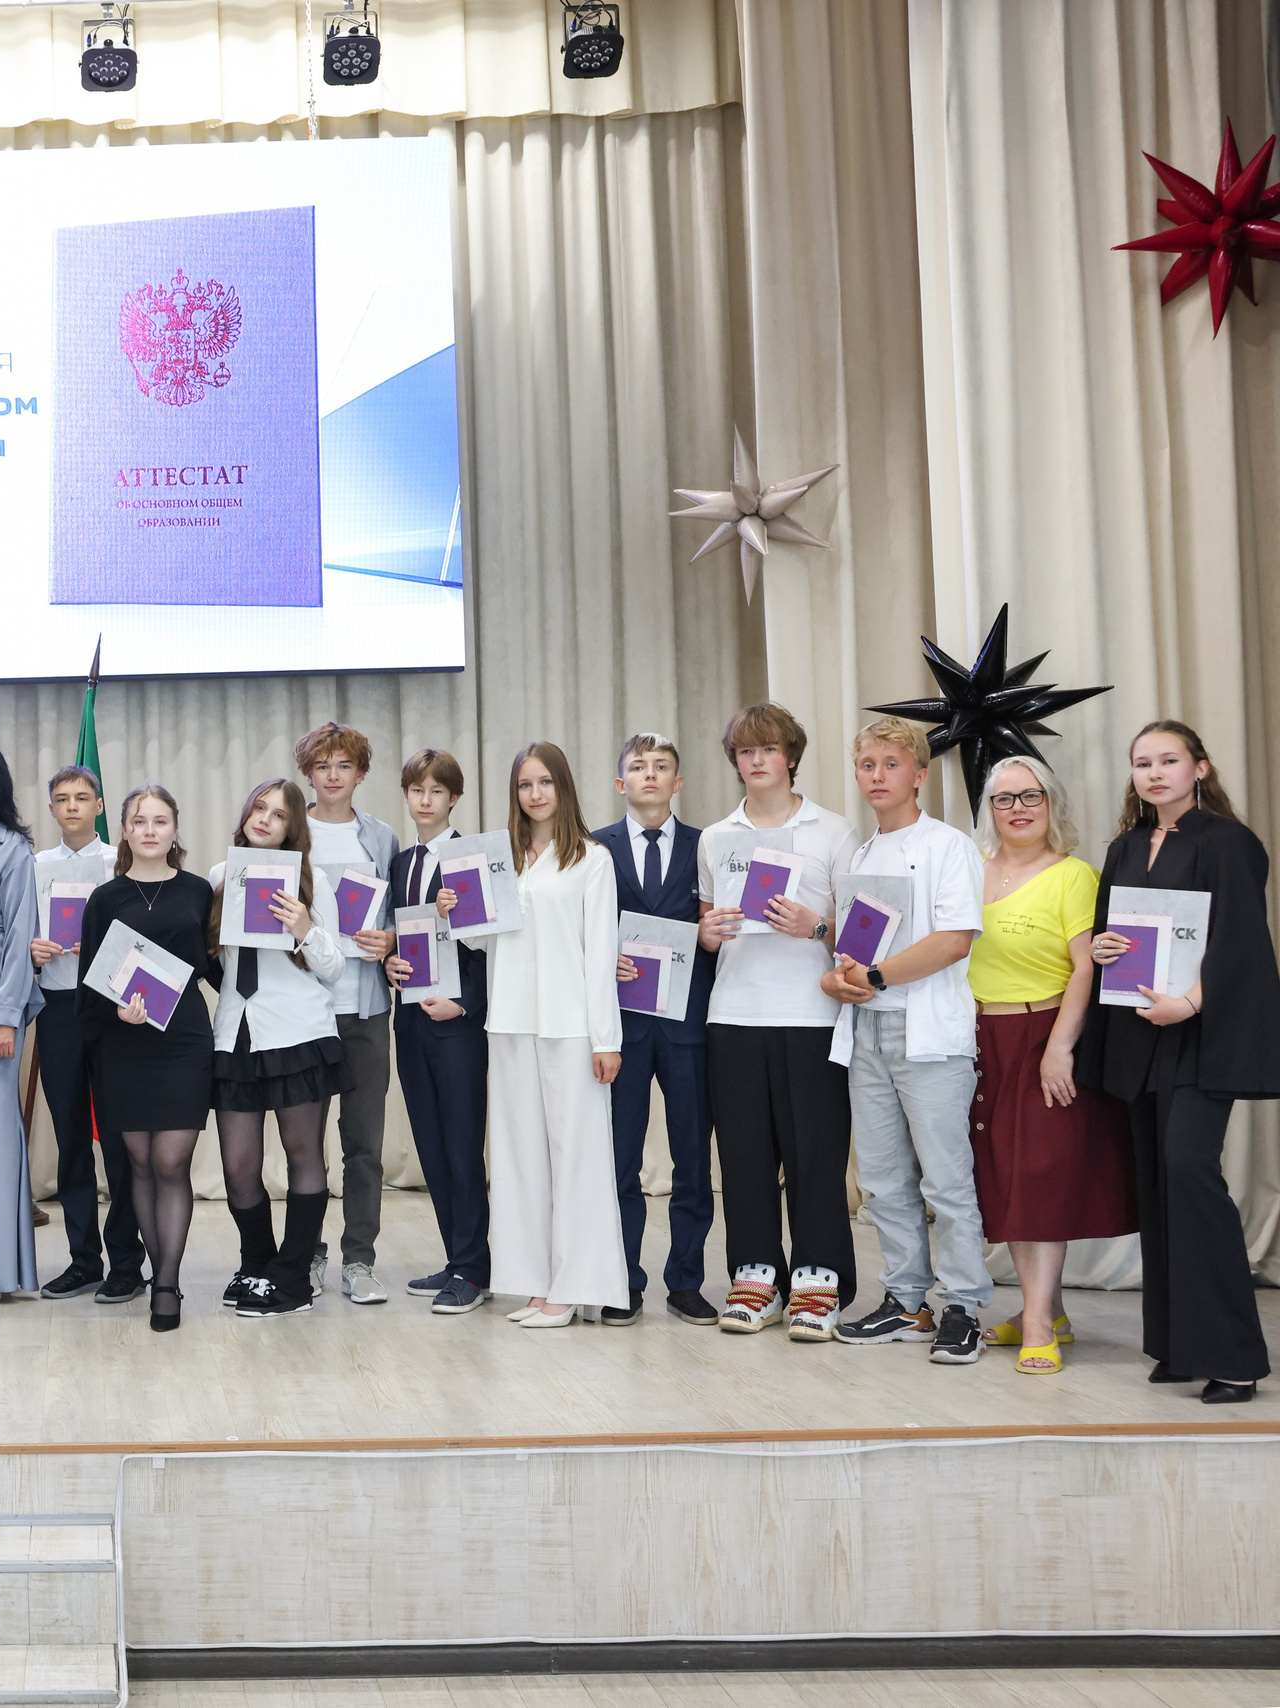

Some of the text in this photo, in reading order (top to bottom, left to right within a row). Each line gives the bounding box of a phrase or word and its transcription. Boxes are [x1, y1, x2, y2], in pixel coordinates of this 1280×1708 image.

[113, 465, 248, 487] АТТЕСТАТ
[116, 498, 242, 509] ОБ ОСНОВНОМ ОБЩЕМ
[139, 517, 220, 527] ОБРАЗОВАНИИ
